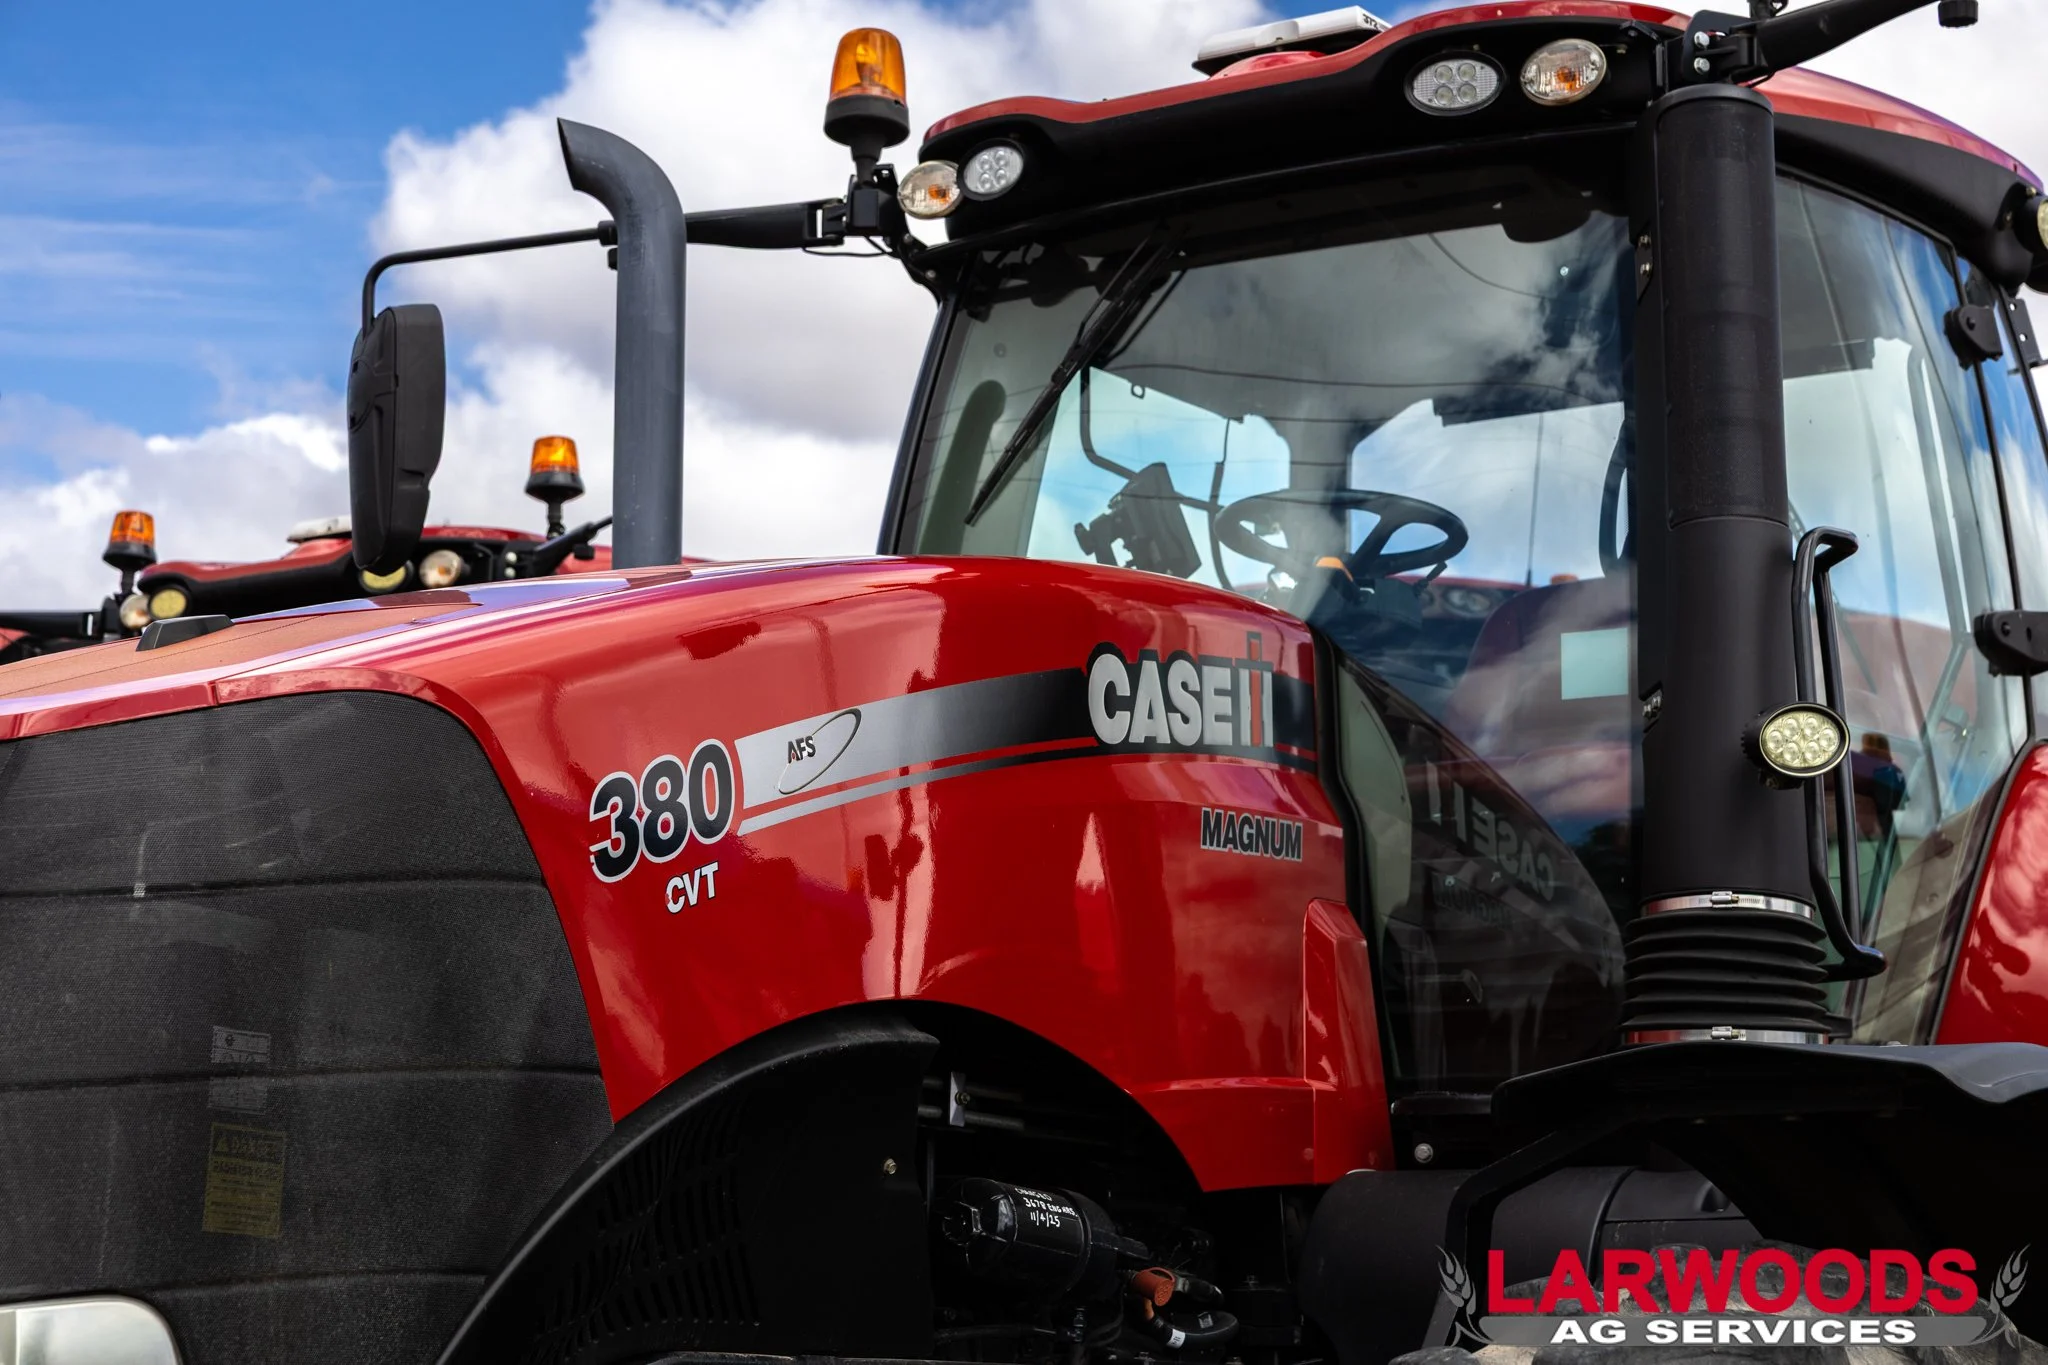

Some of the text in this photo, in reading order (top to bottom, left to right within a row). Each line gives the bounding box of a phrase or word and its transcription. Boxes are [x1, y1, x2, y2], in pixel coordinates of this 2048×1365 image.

[1087, 650, 1233, 747] CASE
[786, 735, 817, 765] AFS
[589, 738, 735, 884] 380
[1200, 806, 1303, 862] MAGNUM
[664, 860, 720, 915] CVT
[1023, 1197, 1047, 1210] 3678
[1046, 1203, 1062, 1213] ENG
[1030, 1210, 1061, 1228] 11/4/25
